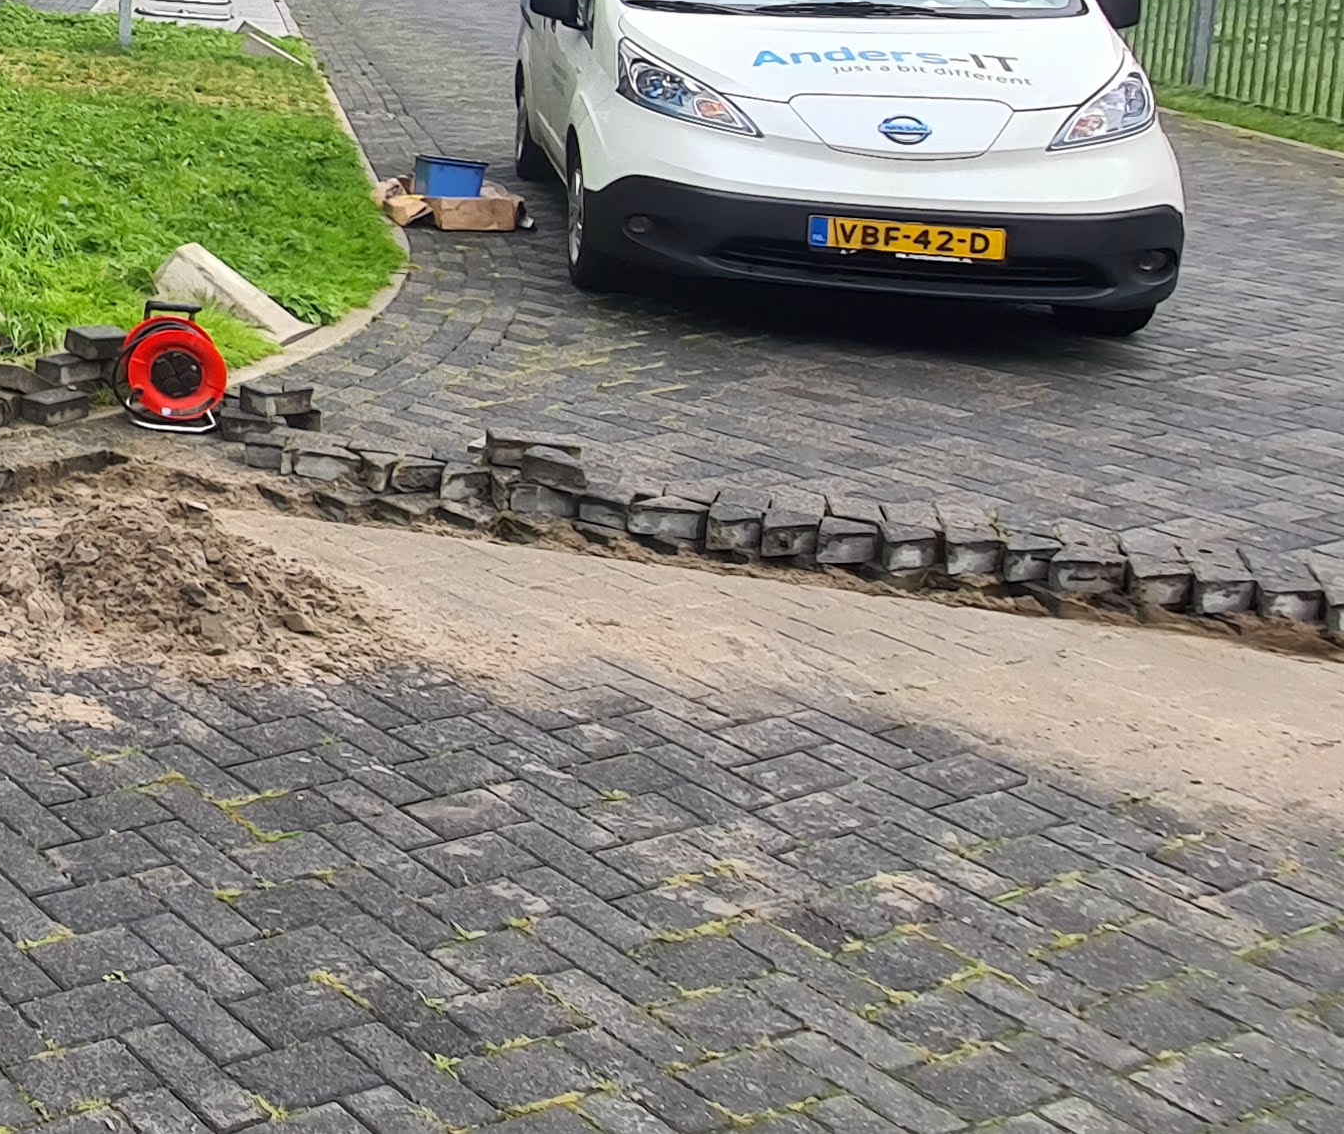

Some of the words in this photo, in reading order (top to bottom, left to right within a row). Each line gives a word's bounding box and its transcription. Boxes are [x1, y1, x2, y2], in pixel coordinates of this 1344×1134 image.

[752, 46, 1019, 73] Anders-IT
[832, 64, 873, 75] just
[879, 65, 891, 73] a
[896, 64, 928, 74] bit
[933, 67, 1033, 87] different
[839, 222, 991, 255] VBF-42-D
